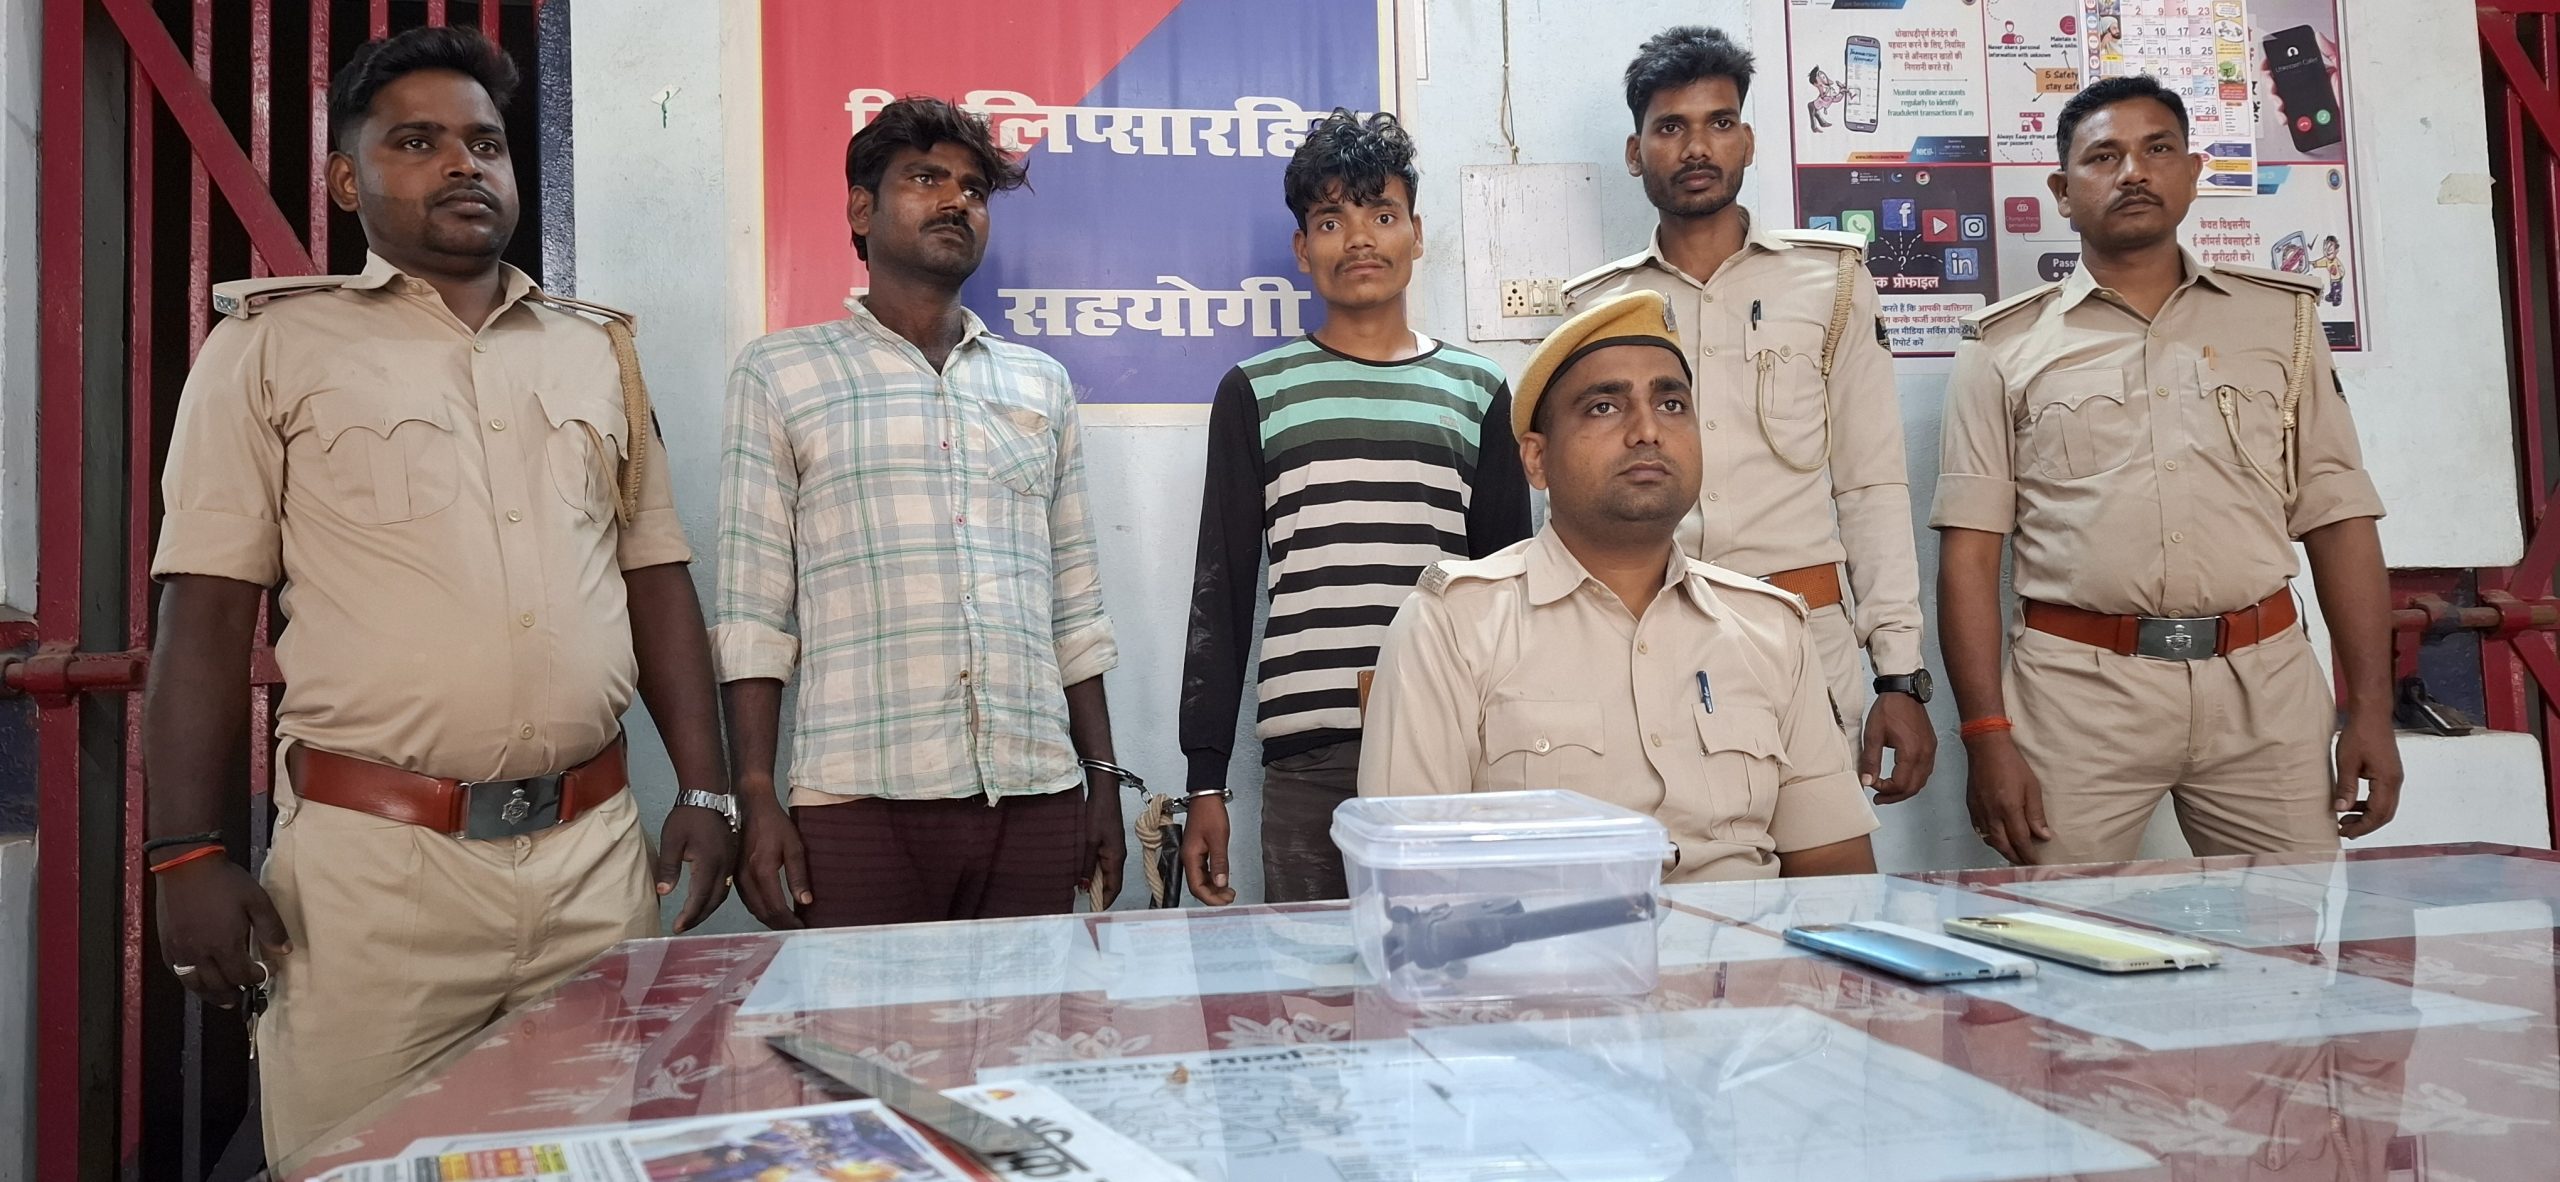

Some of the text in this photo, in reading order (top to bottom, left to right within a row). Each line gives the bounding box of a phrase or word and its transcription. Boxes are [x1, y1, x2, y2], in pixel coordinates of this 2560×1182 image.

[2135, 7, 2210, 16] 2 9 16 23
[1950, 28, 1958, 38] की
[2137, 27, 2212, 36] 3 10 17 24
[1908, 39, 1922, 49] करने
[1923, 39, 1930, 49] के
[1944, 39, 1966, 49] नियमित
[1904, 50, 1910, 60] से
[1911, 51, 1938, 60] ऑनलाइन
[1954, 50, 1962, 60] की
[2138, 47, 2144, 55] 4
[2157, 47, 2167, 55] 11
[2179, 47, 2191, 55] 18
[2201, 47, 2213, 55] 25
[1904, 62, 1926, 71] निगरानी
[1928, 62, 1941, 71] करते
[2139, 67, 2215, 75] 5 12 19 26
[2045, 70, 2078, 82] 5 Safety
[1893, 88, 1917, 96] Monitor
[1918, 88, 1937, 96] online
[2046, 84, 2062, 93] stay
[2181, 87, 2193, 96] 20
[2204, 87, 2216, 96] 27
[1900, 99, 1927, 107] regularly
[1936, 99, 1959, 107] identify
[1888, 109, 1918, 117] fraudulent
[1920, 109, 1957, 117] transactions
[1964, 110, 1974, 118] any
[2186, 107, 2217, 115] 1 28
[958, 89, 1374, 158] लिप्सारहि
[2190, 127, 2196, 136] 2
[1997, 133, 2014, 141] Always
[2200, 217, 2250, 230] केवल विश्वसनीय
[2253, 233, 2260, 246] से
[2202, 249, 2210, 262] ही
[2211, 249, 2238, 262] खरीदारी
[1872, 273, 1940, 290] क प्रोफाइल
[997, 275, 1312, 338] सहयोगी
[1882, 303, 1898, 312] करते
[1906, 304, 1916, 312] कि
[1918, 303, 1941, 312] आपकी
[1943, 303, 1973, 312] व्यक्तिगत
[1892, 315, 1910, 324] करके
[1930, 315, 1956, 323] अकाउंट
[1902, 326, 1924, 335] मीडिया
[1926, 326, 1946, 335] सर्विस
[1892, 337, 1910, 346] रिपोर्ट
